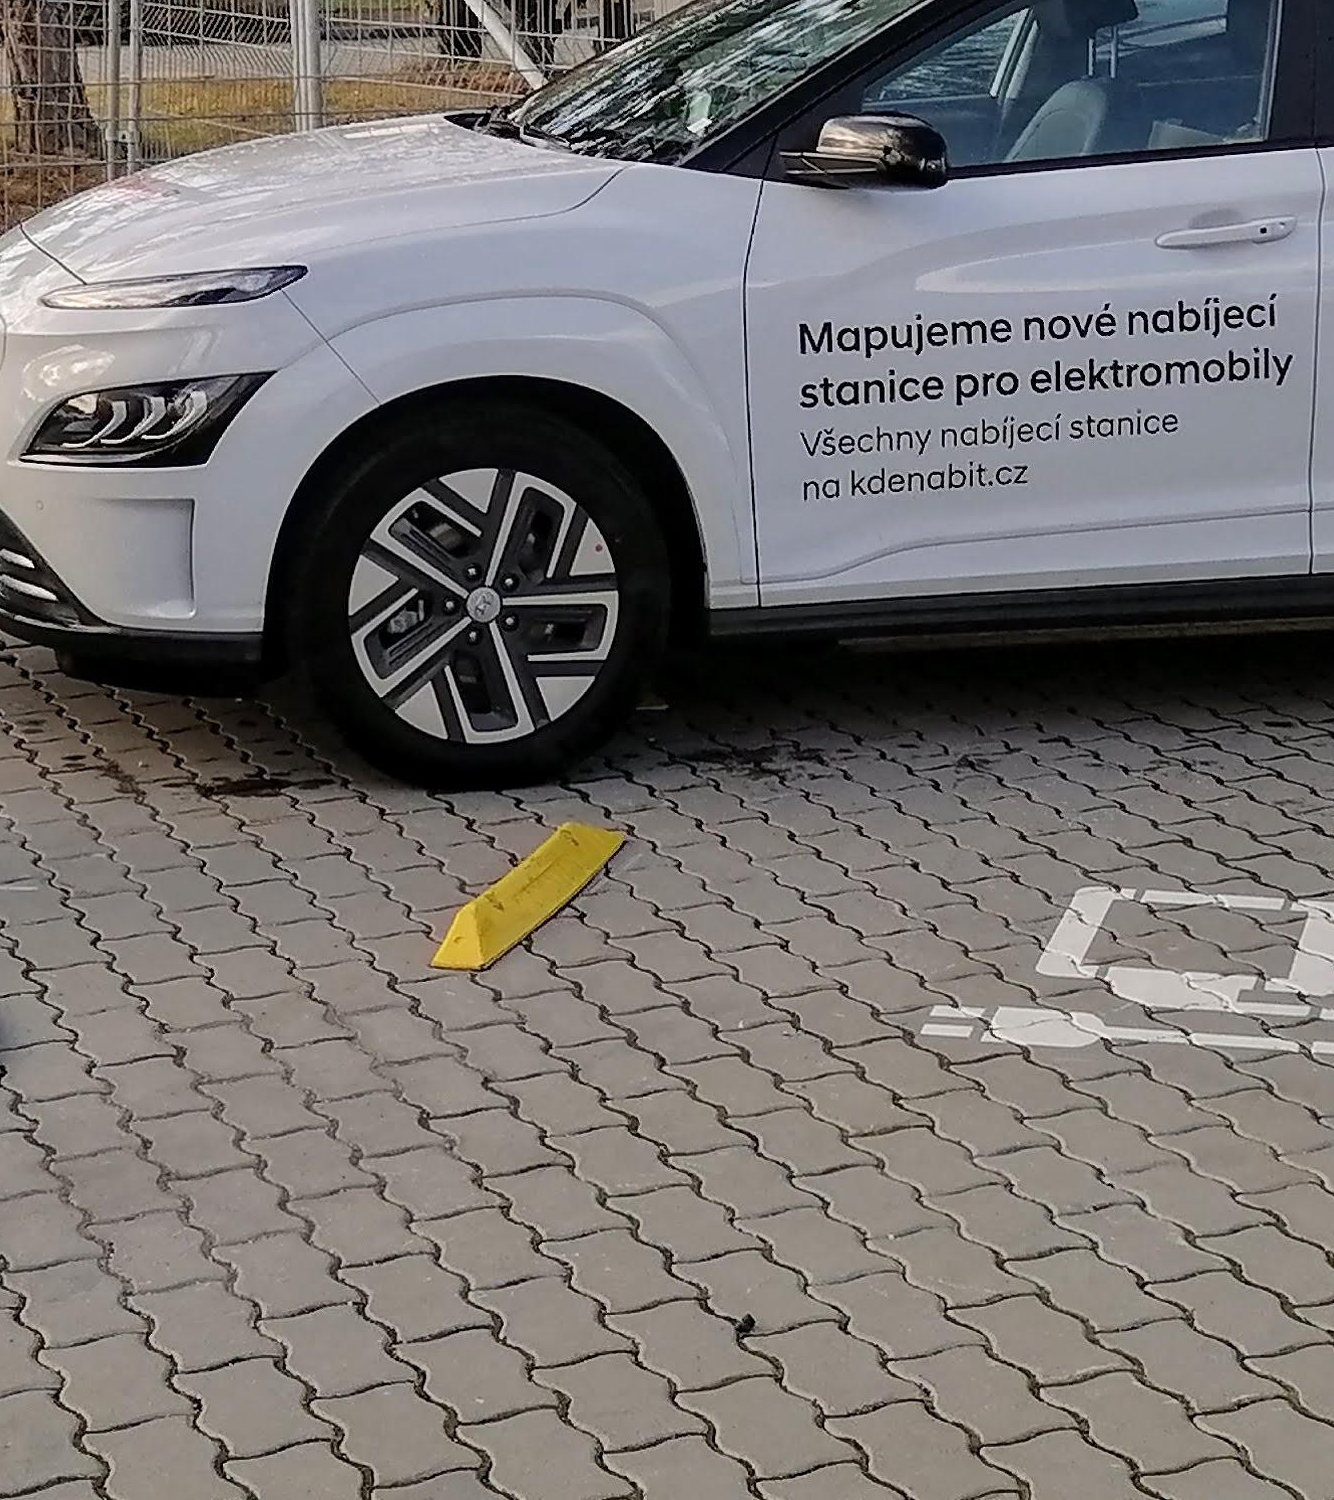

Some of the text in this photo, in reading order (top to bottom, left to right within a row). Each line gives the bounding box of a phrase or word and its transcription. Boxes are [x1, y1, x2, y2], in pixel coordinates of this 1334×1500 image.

[798, 292, 1277, 357] Mapujeme nové nabíjecí
[799, 347, 1294, 409] stanice pro elektromobily
[799, 408, 1180, 457] Všechny nabíjecí stanice
[802, 460, 1029, 501] na kdenabit.cz
